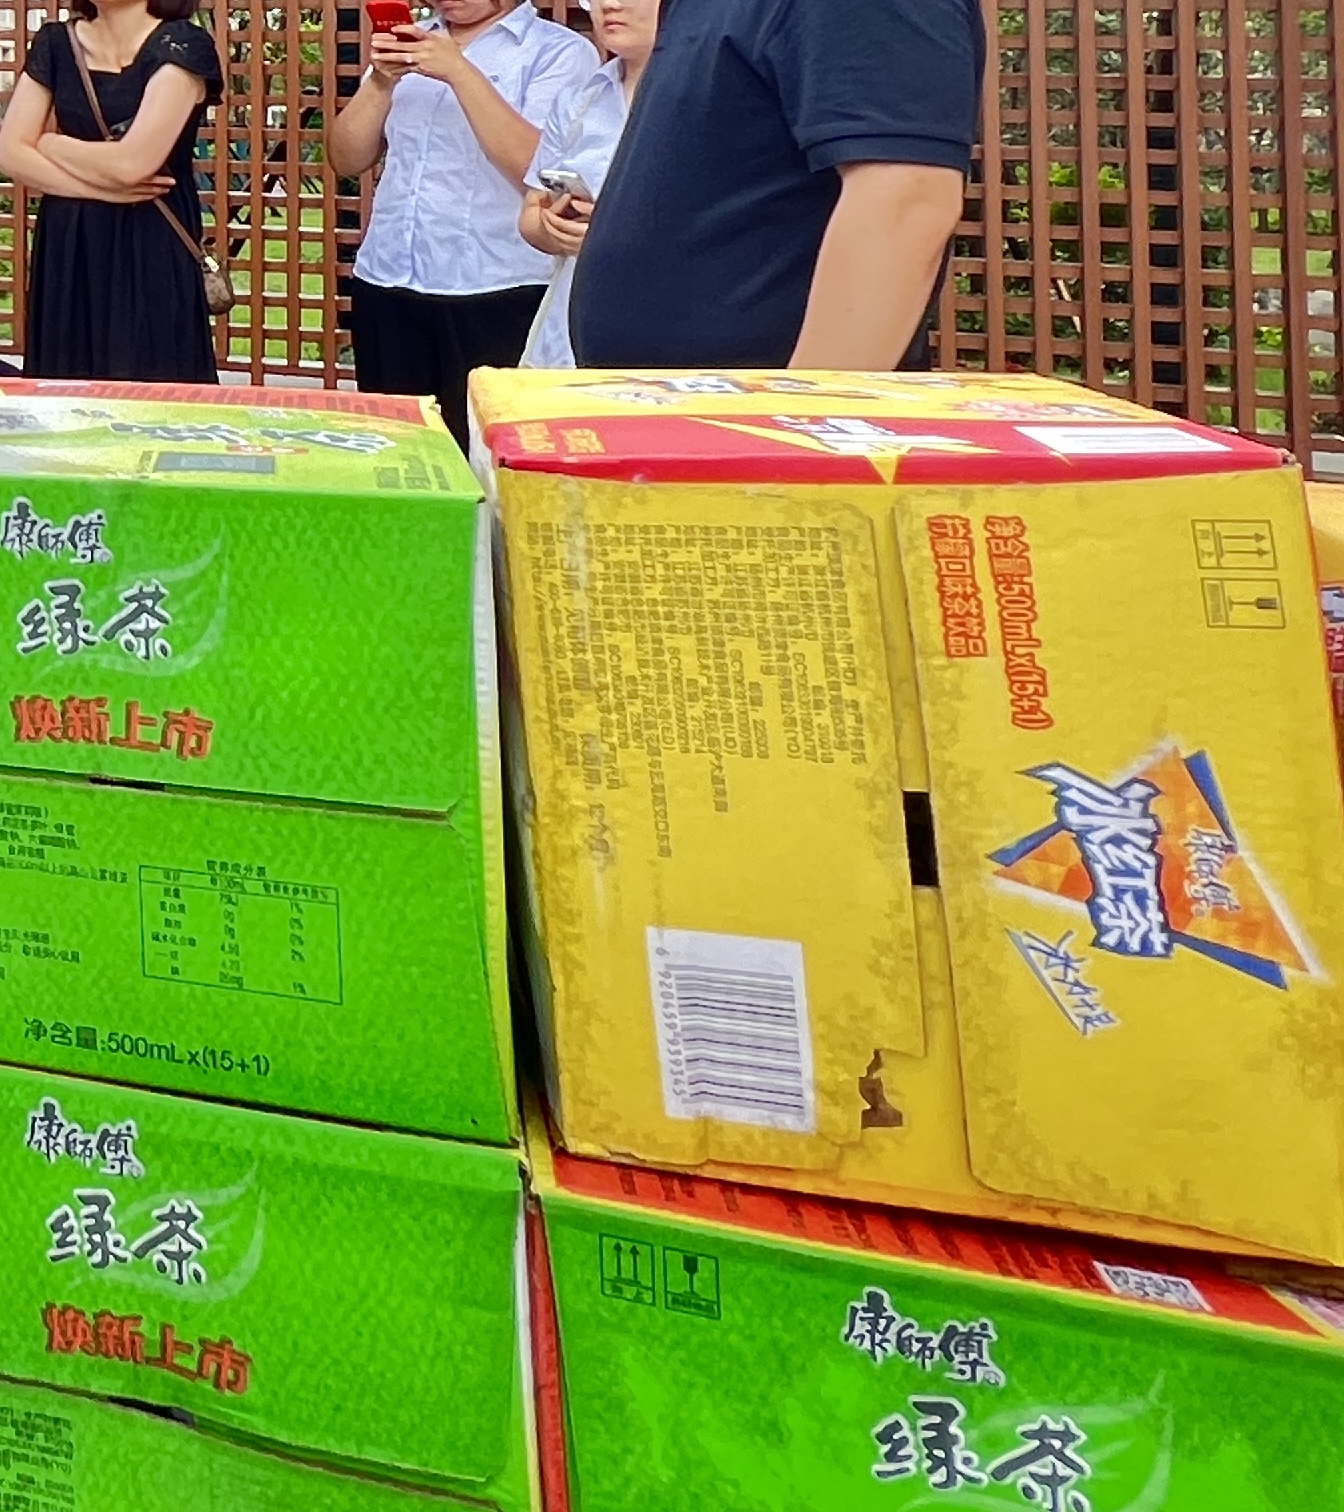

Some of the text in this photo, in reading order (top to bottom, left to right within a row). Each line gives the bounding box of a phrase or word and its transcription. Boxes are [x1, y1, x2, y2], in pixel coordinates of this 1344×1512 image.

[16, 577, 171, 661] 绿茶
[926, 514, 989, 658] 柠檬口味茶饮品
[9, 693, 214, 761] 焕新上市
[1016, 762, 1174, 959] 冰红茶
[46, 1189, 207, 1285] 绿茶
[42, 1301, 253, 1396] 焕新上市
[873, 1397, 1091, 1512] 绿茶
